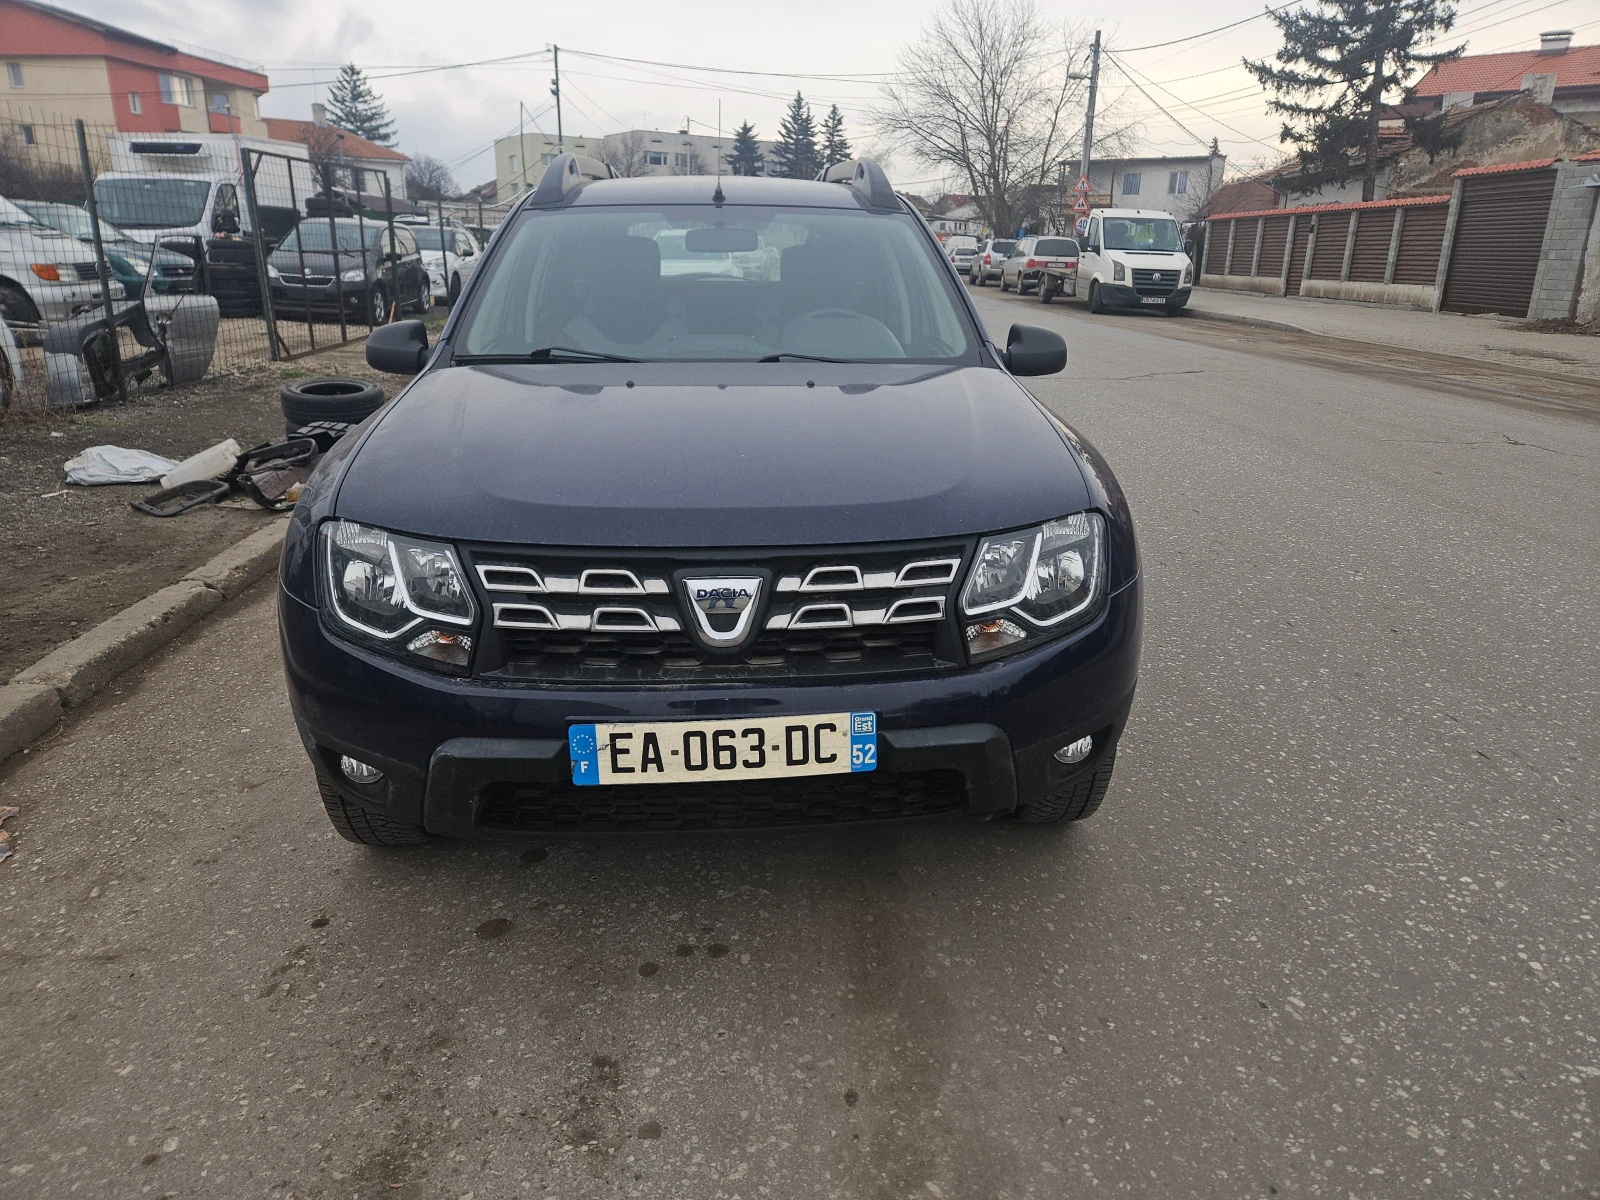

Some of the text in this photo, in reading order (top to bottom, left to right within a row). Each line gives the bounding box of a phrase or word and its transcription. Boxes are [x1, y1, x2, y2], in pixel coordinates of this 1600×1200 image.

[1078, 219, 1087, 230] 40
[697, 588, 749, 599] DACIA
[855, 720, 873, 732] Est
[852, 743, 876, 765] 52
[580, 761, 589, 774] F
